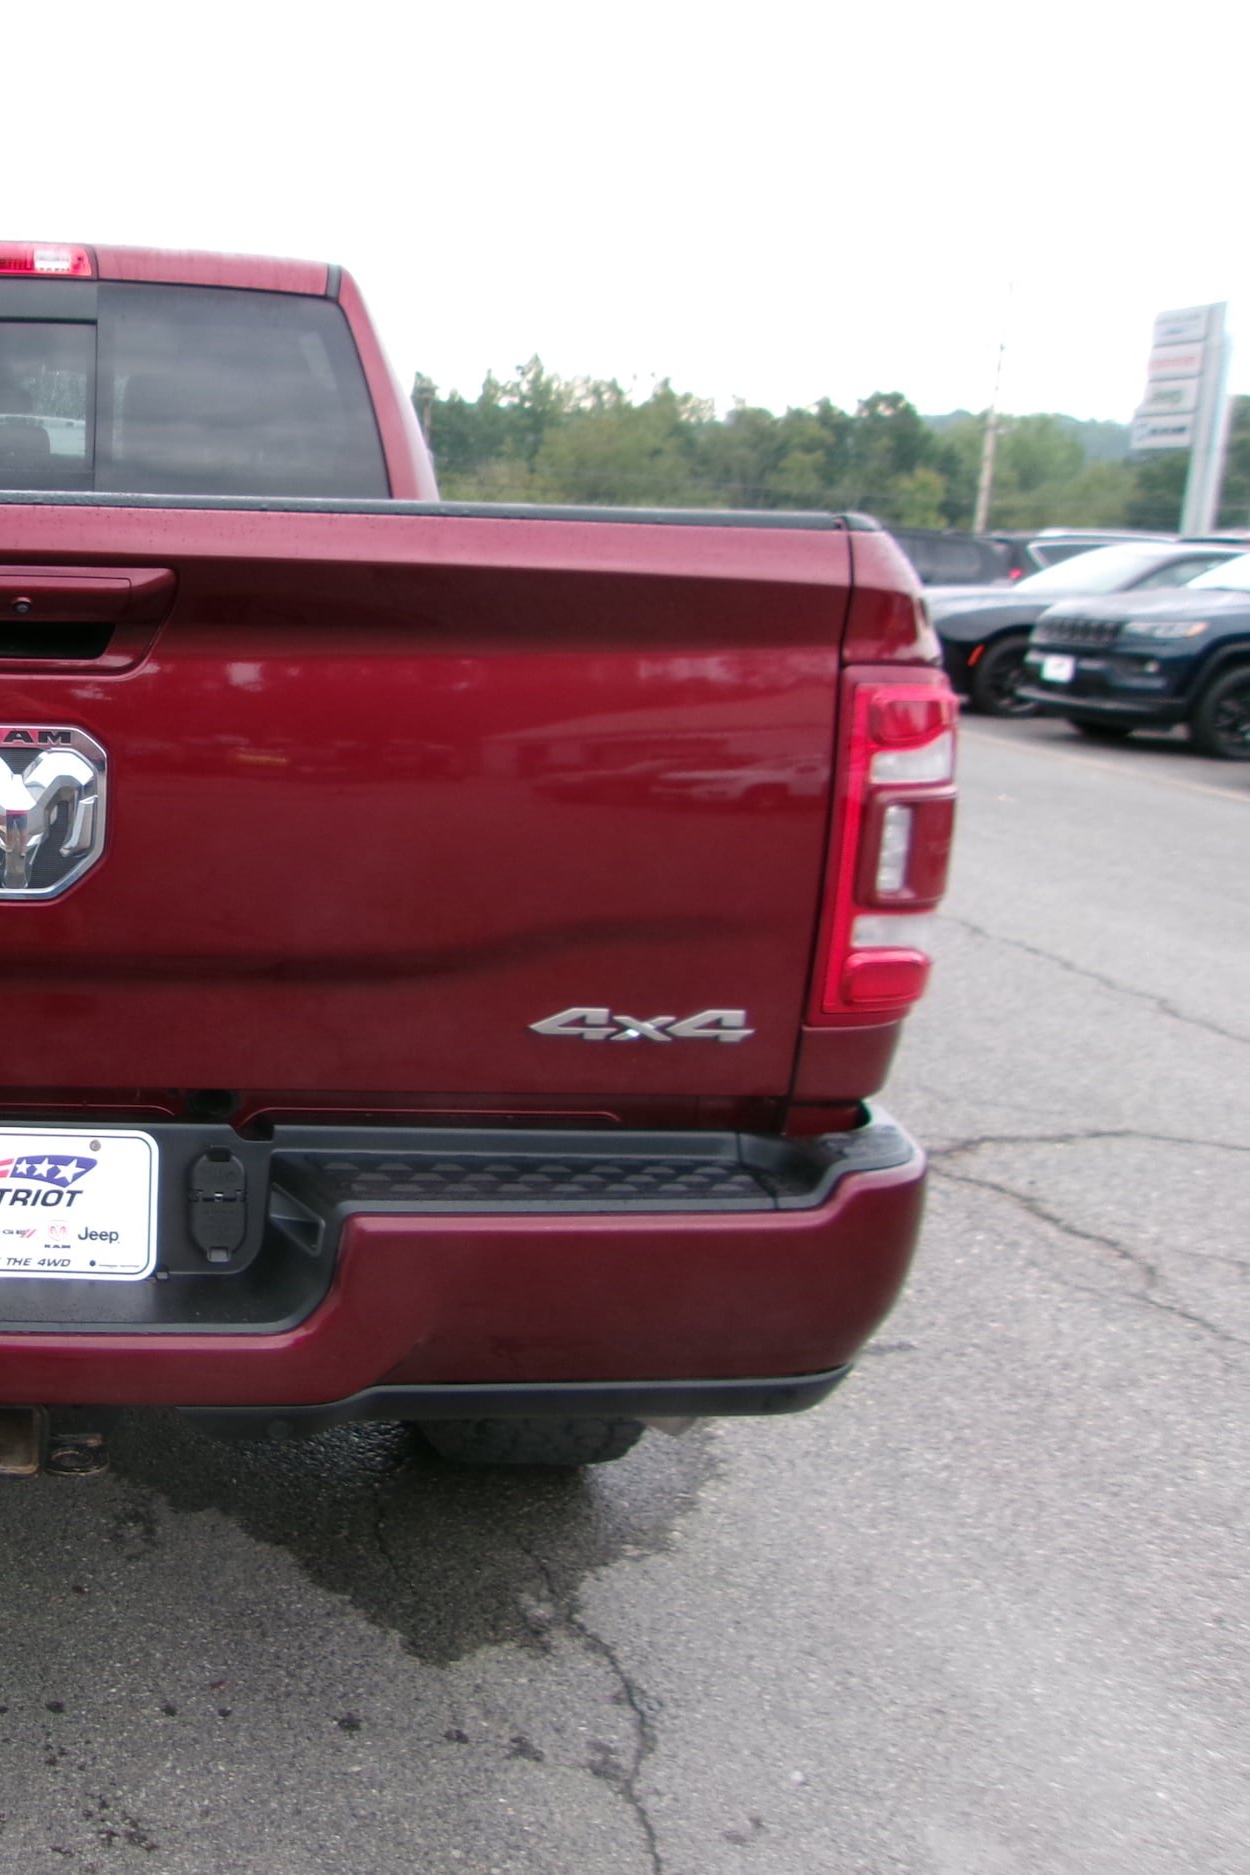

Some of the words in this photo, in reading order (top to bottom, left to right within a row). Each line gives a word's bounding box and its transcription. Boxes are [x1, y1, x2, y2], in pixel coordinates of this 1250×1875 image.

[77, 1225, 119, 1245] Jeep
[6, 1257, 32, 1268] THE
[36, 1258, 71, 1269] 4WD
